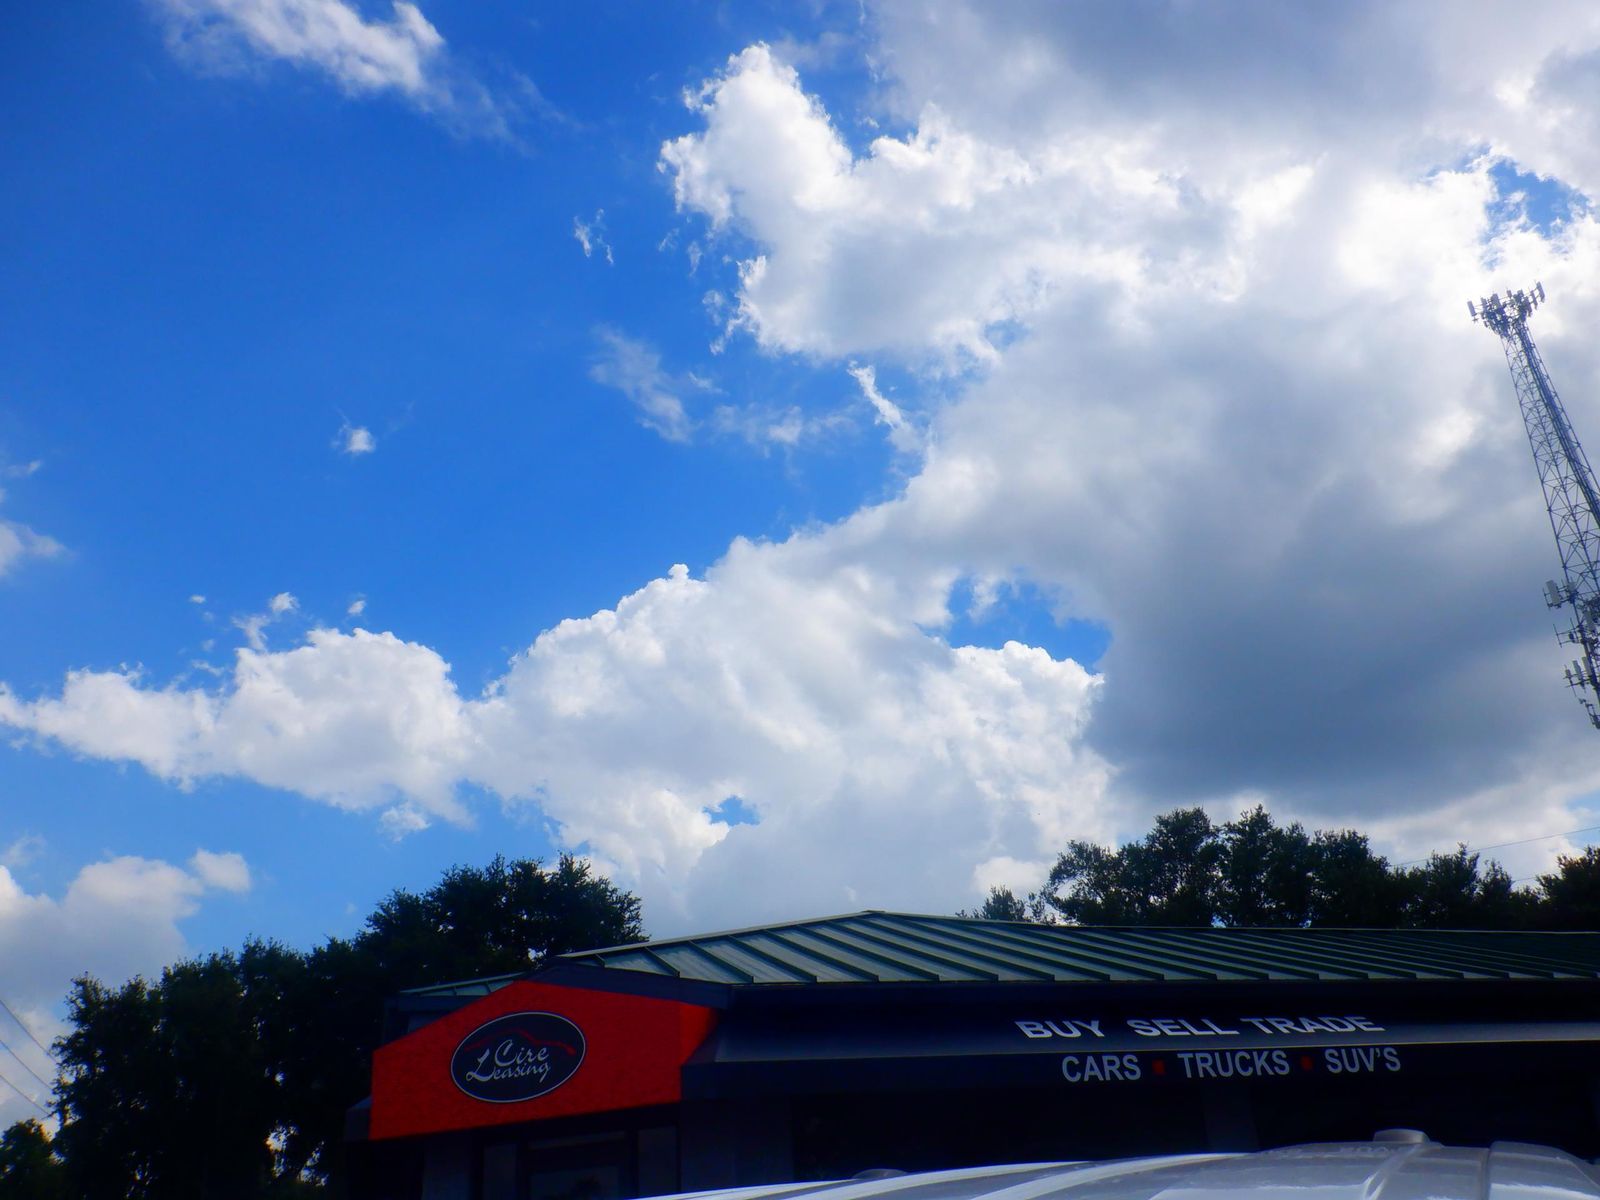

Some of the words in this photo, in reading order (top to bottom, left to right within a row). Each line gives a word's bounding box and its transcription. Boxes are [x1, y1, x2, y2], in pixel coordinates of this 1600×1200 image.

[1014, 1020, 1105, 1039] BUY
[1126, 1018, 1239, 1037] SELL
[1241, 1016, 1385, 1035] TRADE
[465, 1048, 551, 1083] Leasing
[494, 1039, 549, 1066] Cire
[1061, 1054, 1142, 1083] CARS
[1177, 1049, 1290, 1079] TRUCKS
[1324, 1047, 1401, 1074] SUV'S
